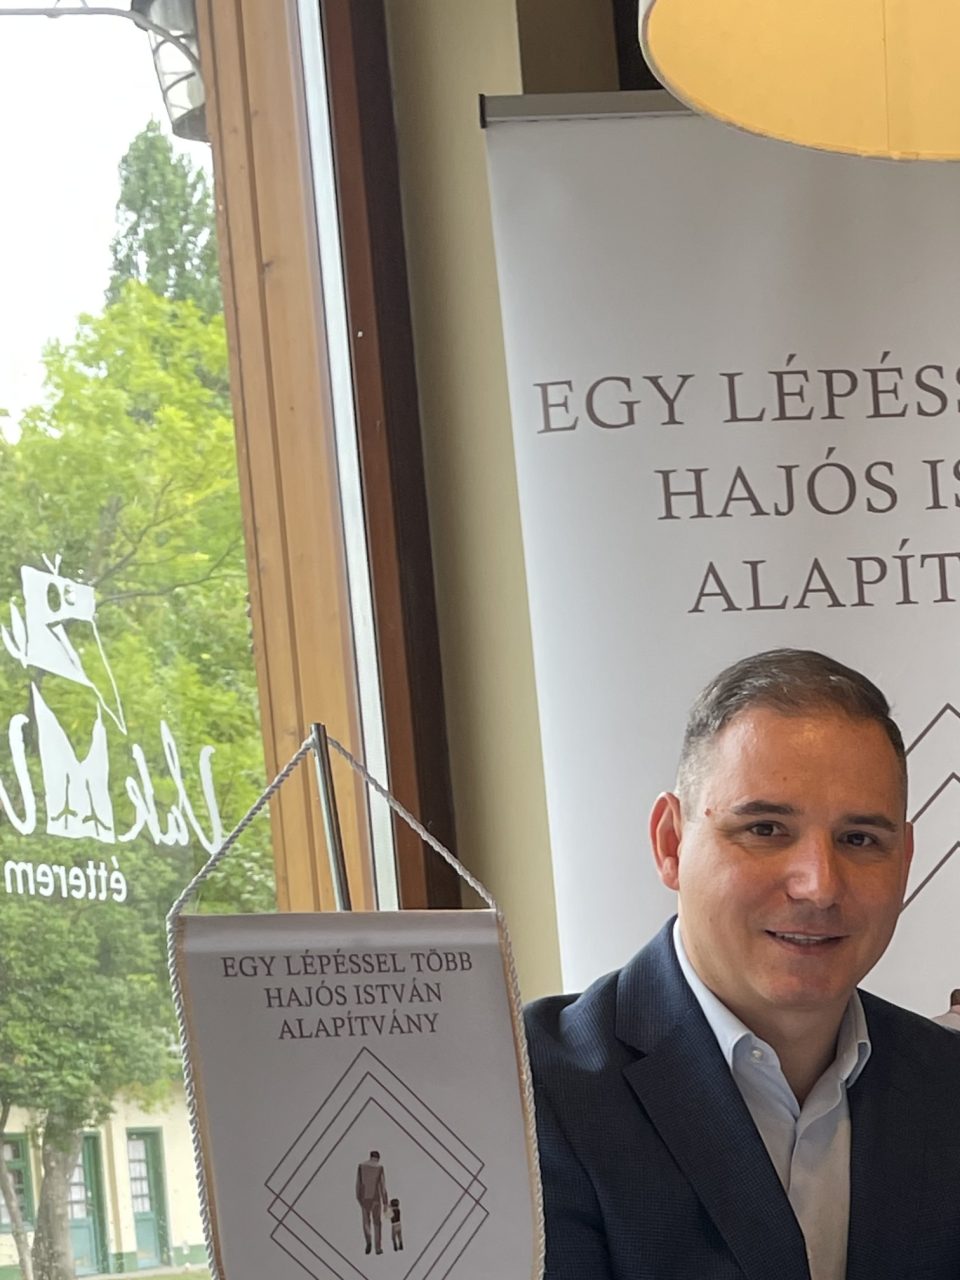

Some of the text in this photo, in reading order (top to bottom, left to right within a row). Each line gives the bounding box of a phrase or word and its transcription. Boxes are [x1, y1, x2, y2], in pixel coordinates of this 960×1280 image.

[534, 373, 695, 434] EGY
[654, 447, 897, 520] HAJÓS
[221, 947, 473, 978] EGY LÉPÉSSEL TÖBB
[264, 977, 442, 1009] HAJÓS ISTVÁN
[279, 1010, 439, 1040] ALAPÍTVÁNY
